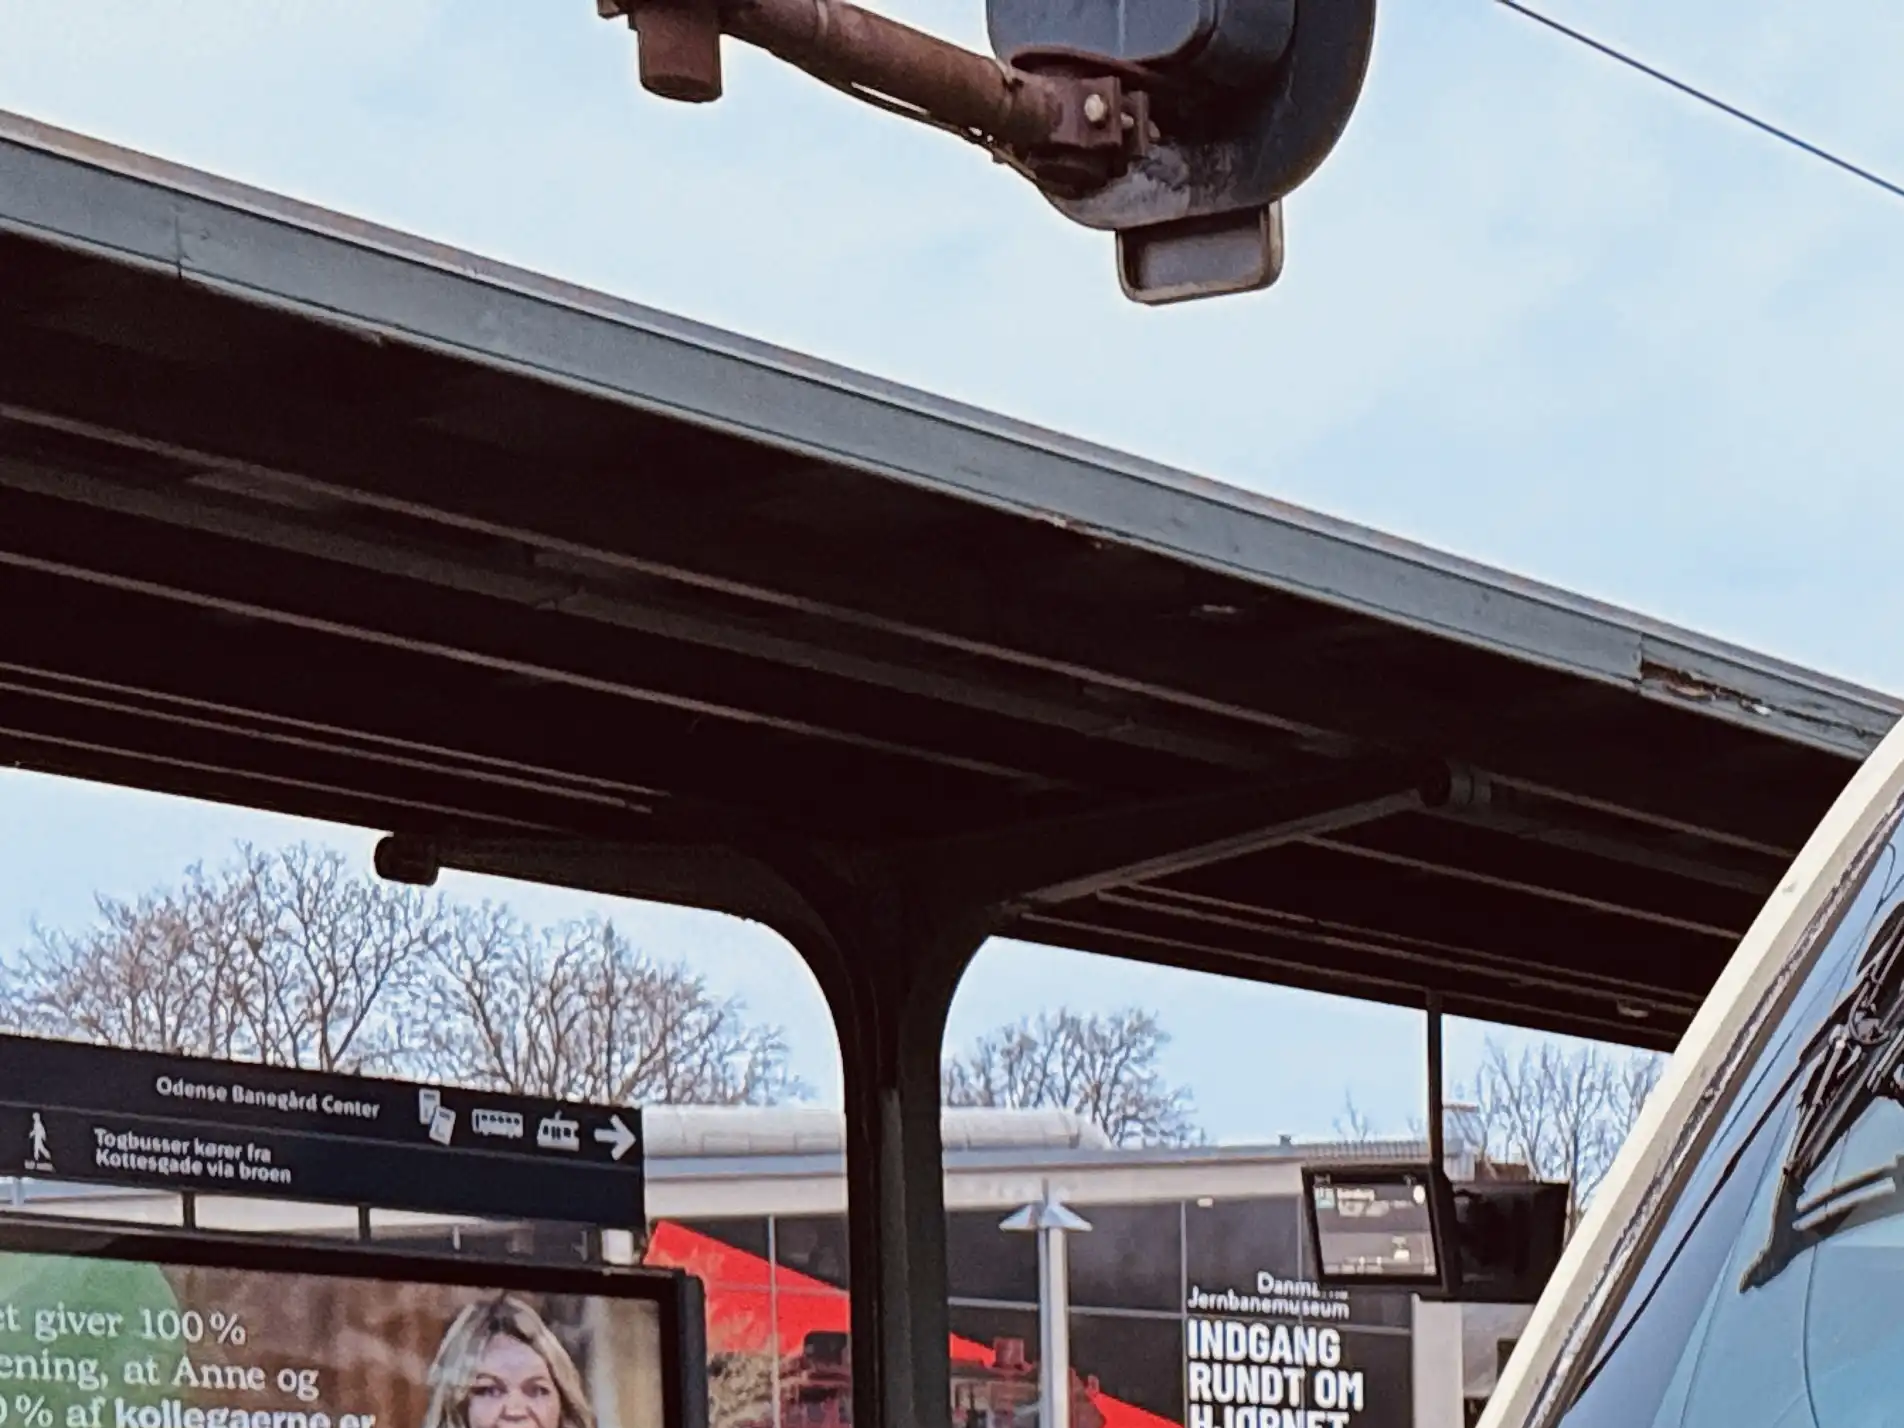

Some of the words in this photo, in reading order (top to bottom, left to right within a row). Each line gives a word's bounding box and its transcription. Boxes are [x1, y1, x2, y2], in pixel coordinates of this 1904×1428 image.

[156, 1076, 228, 1102] Odense
[232, 1085, 318, 1112] Banegård
[322, 1094, 380, 1119] Center
[94, 1128, 190, 1155] Togbusser
[247, 1142, 272, 1163] fra
[96, 1148, 201, 1176] Kottesgade
[207, 1158, 234, 1178] via
[239, 1162, 292, 1183] broen
[34, 1302, 124, 1342] giver
[1188, 1285, 1350, 1319] Jernbanemuseum
[1188, 1318, 1341, 1367] INDGANG
[123, 1355, 161, 1386] at
[172, 1355, 266, 1390] Anne
[277, 1366, 320, 1401] og
[1188, 1361, 1306, 1407] RUNDT
[1314, 1368, 1364, 1412] OM
[66, 1396, 108, 1428] af
